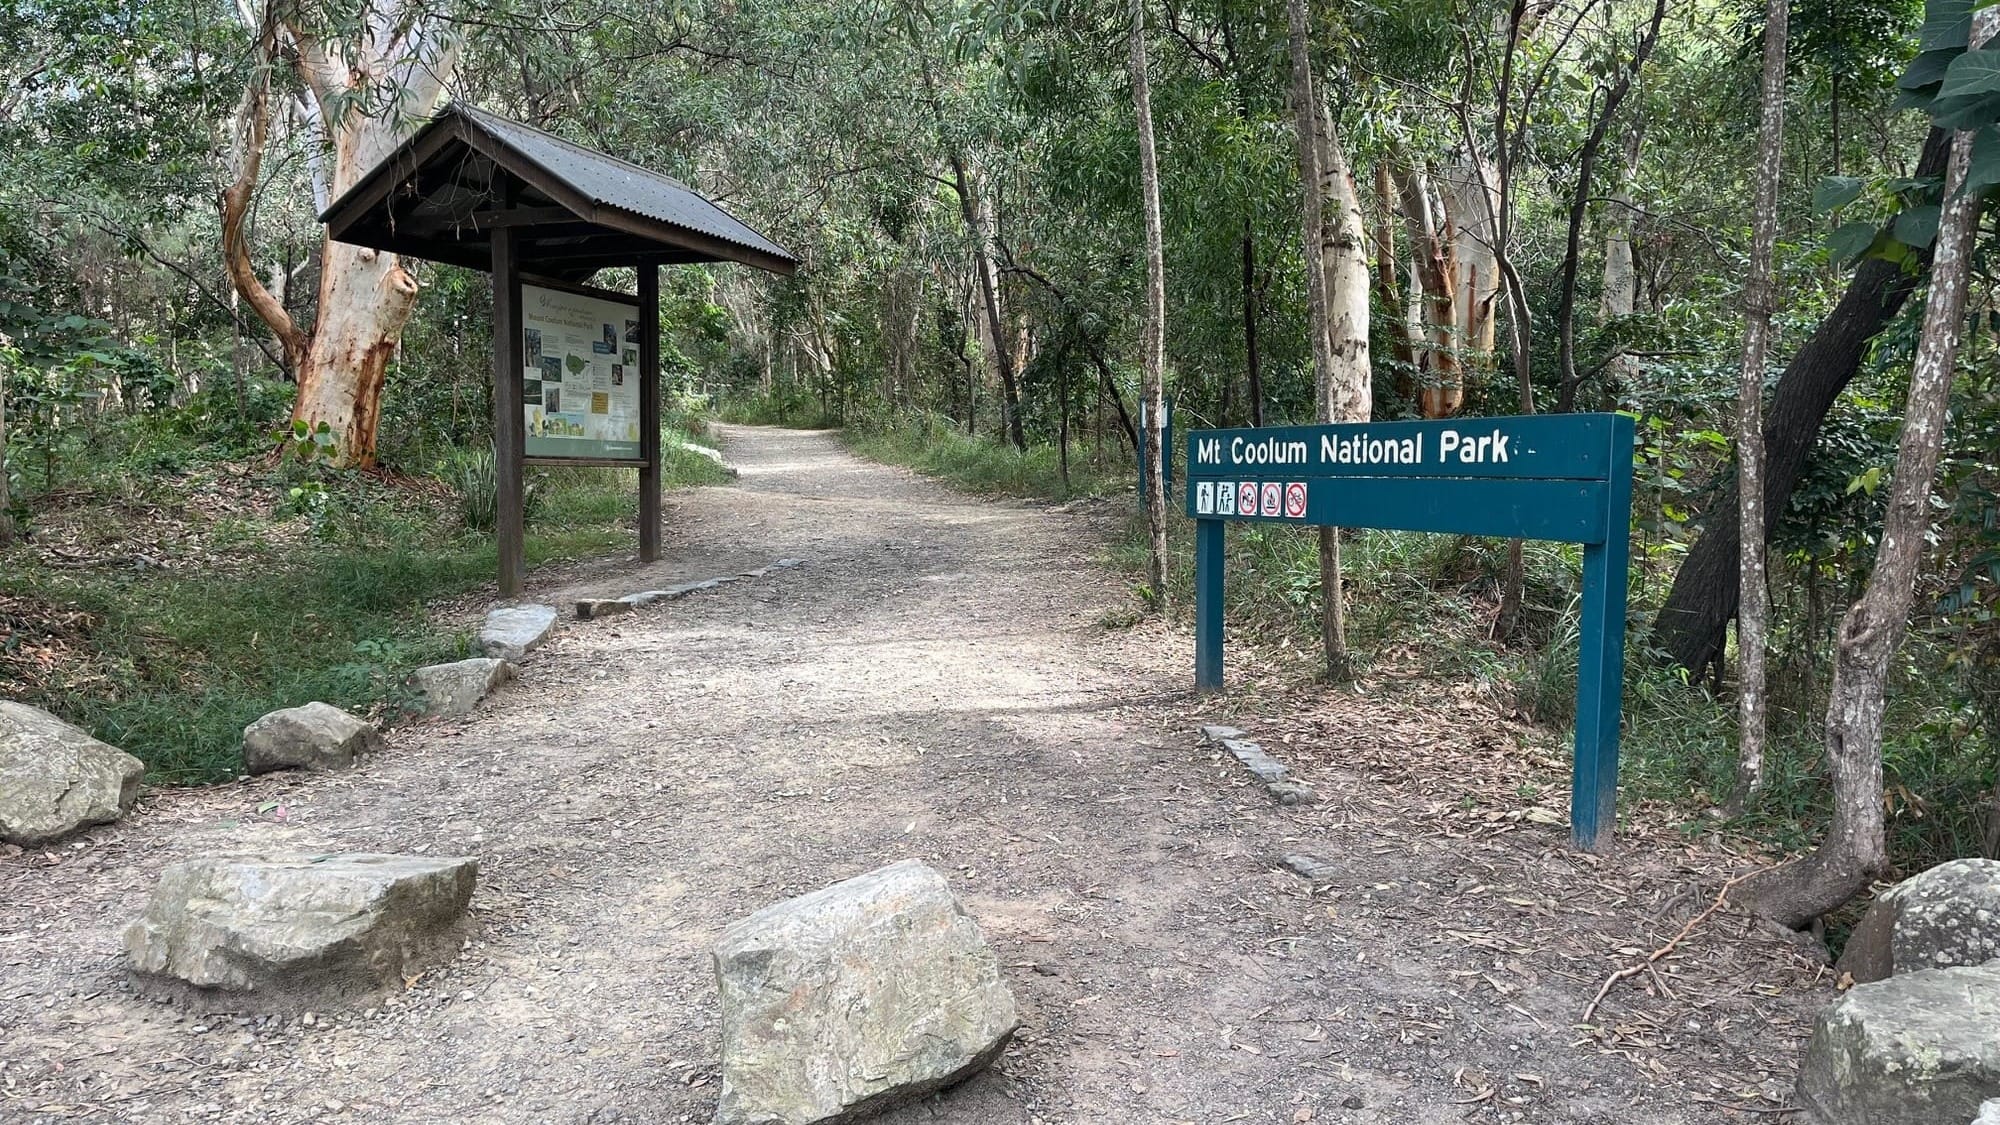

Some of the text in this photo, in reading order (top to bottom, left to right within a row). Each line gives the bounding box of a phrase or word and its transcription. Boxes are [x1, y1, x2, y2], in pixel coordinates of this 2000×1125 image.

[1198, 429, 1509, 464] Mt Coolum National Park
